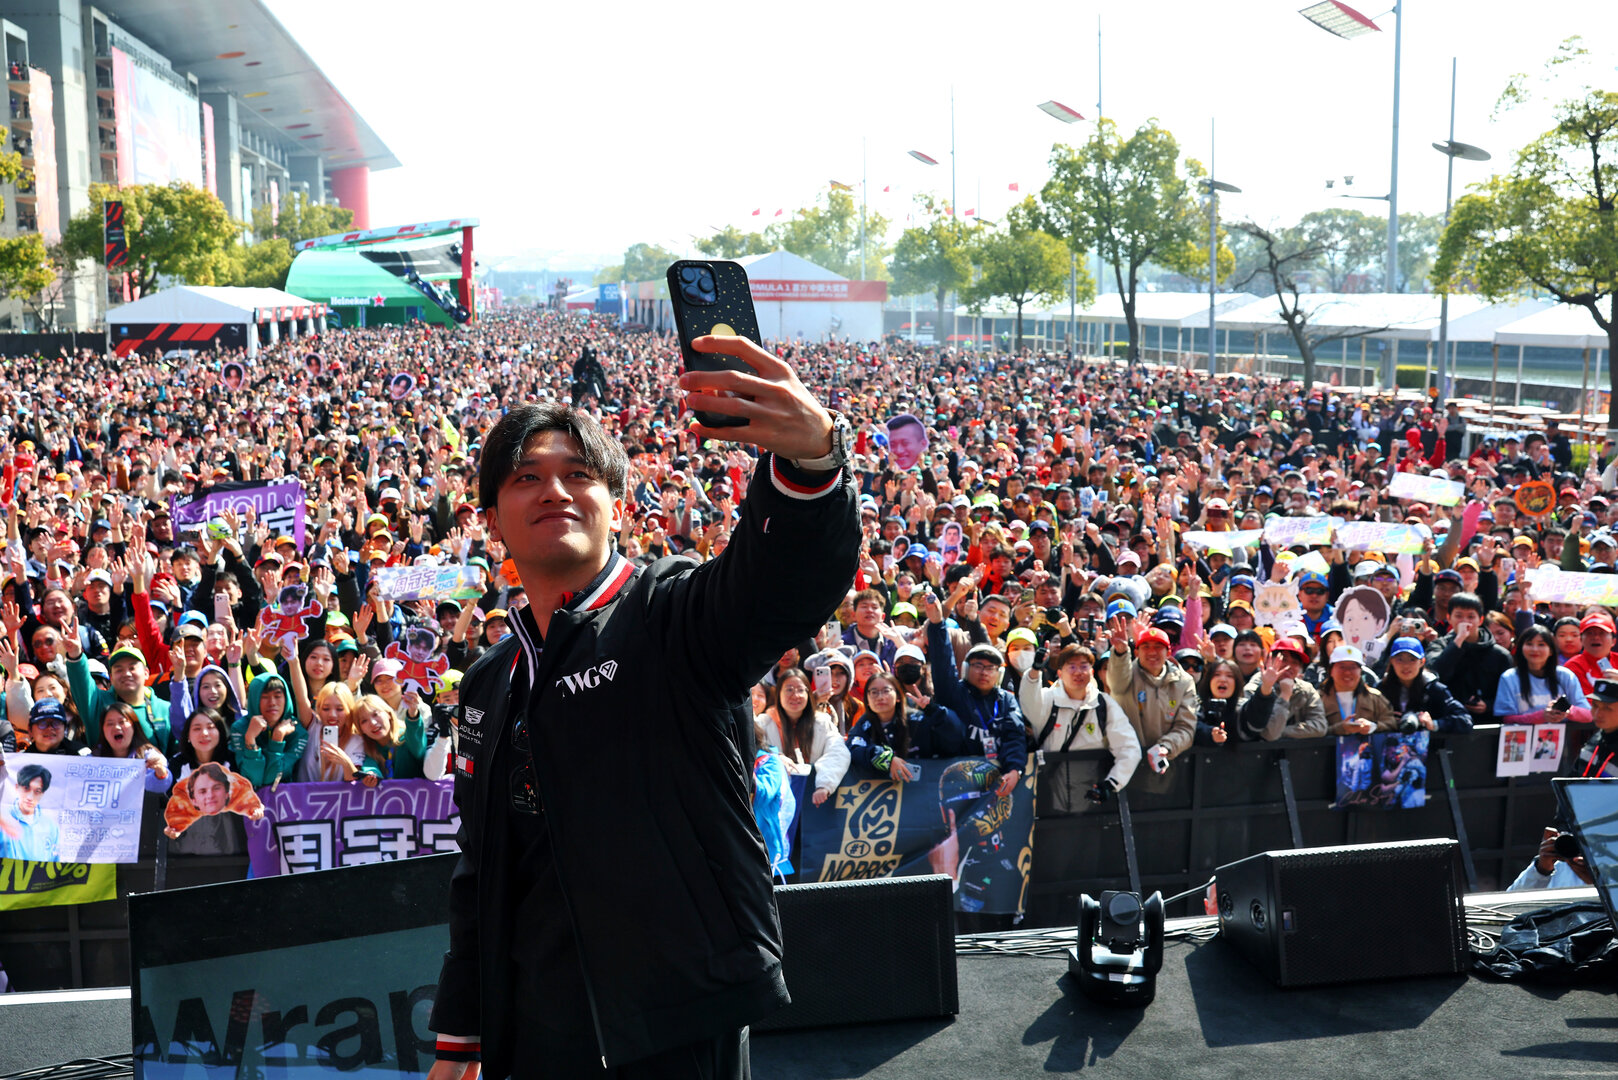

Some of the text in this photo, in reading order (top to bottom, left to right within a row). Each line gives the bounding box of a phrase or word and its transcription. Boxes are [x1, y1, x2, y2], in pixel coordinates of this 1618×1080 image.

[331, 296, 370, 305] Heineken
[392, 569, 437, 595] 周冠宇
[65, 763, 139, 778] 只为你而来
[59, 810, 135, 824] 我们会一直
[65, 828, 109, 841] 支持你
[850, 843, 865, 855] #1
[822, 860, 897, 881] NORRIS
